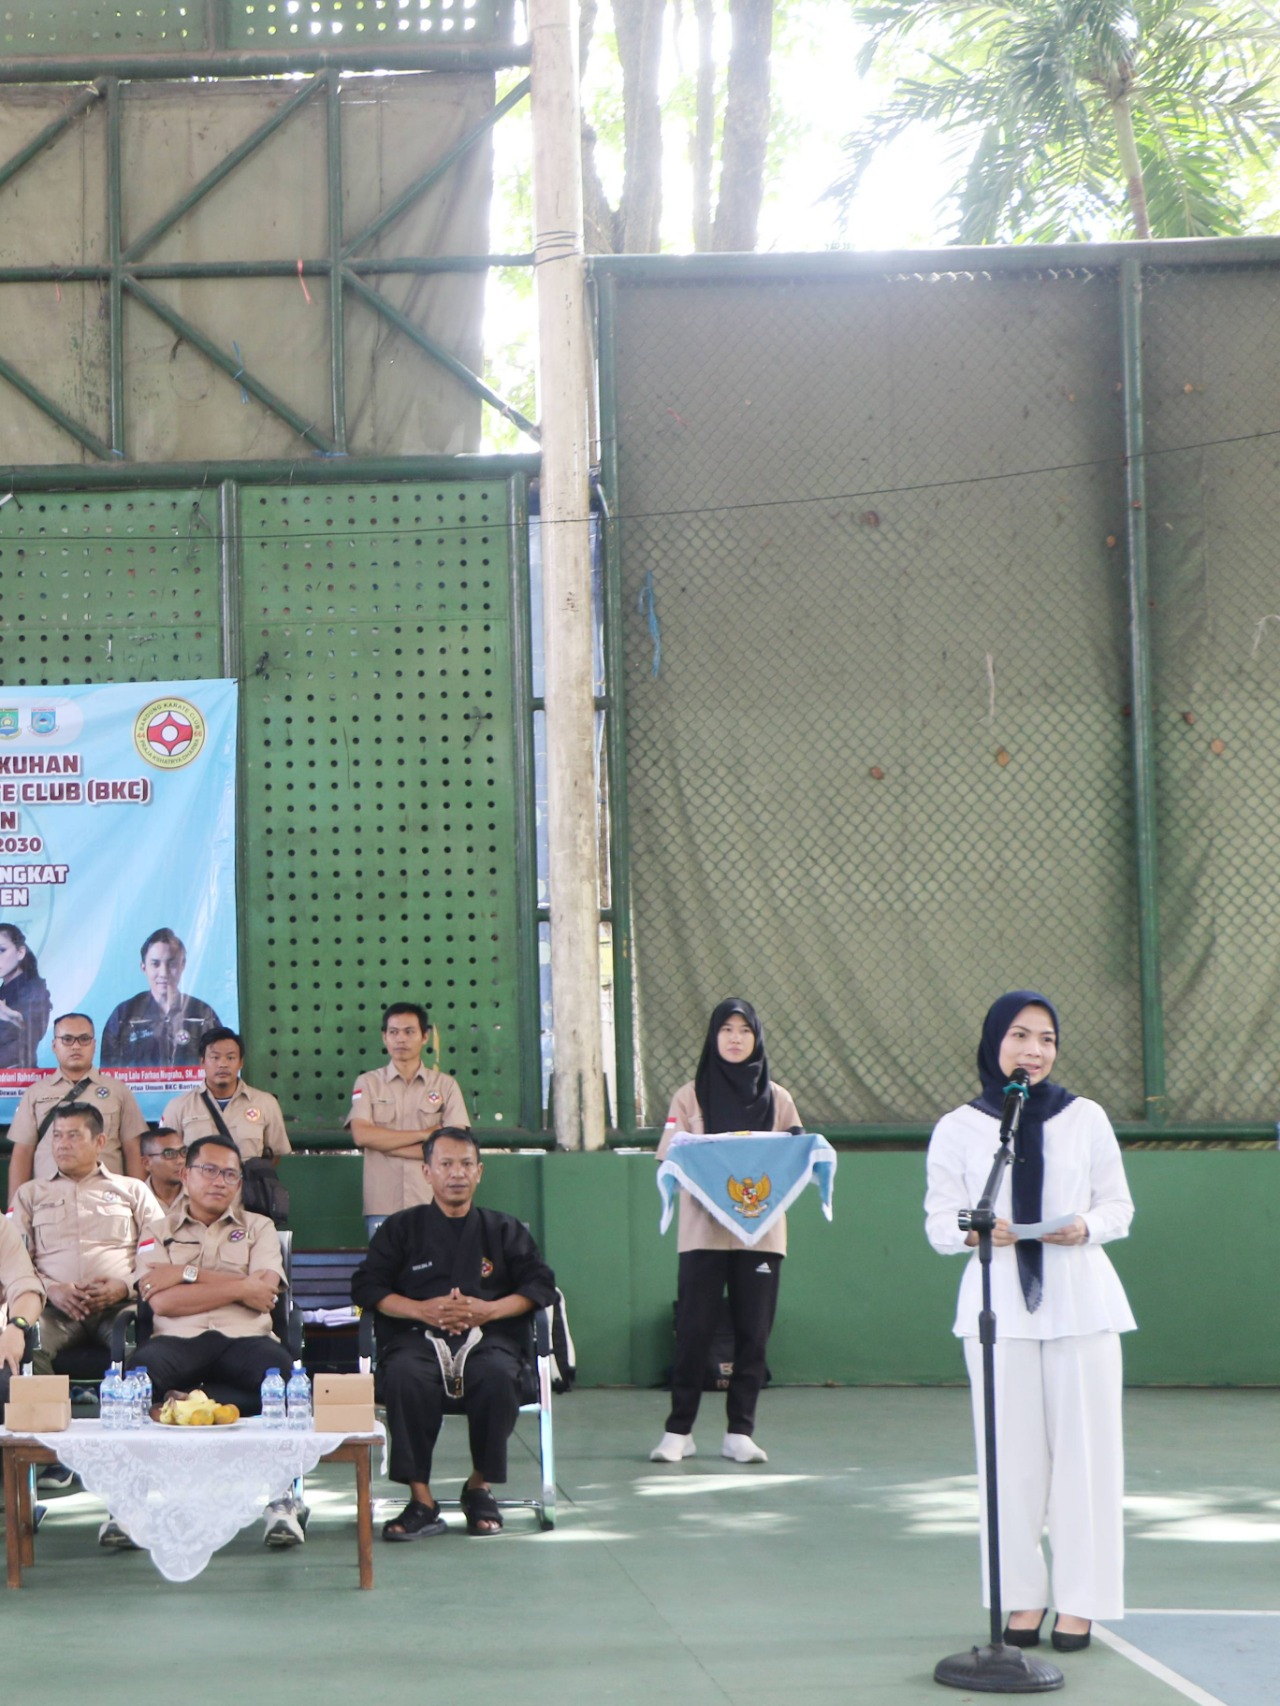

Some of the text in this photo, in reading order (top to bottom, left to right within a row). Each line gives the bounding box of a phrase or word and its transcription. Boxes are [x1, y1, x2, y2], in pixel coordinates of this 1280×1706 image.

[139, 702, 200, 731] BANDUNG KARATE CLUB
[22, 782, 81, 802] CLUB
[87, 778, 149, 803] (BKC)
